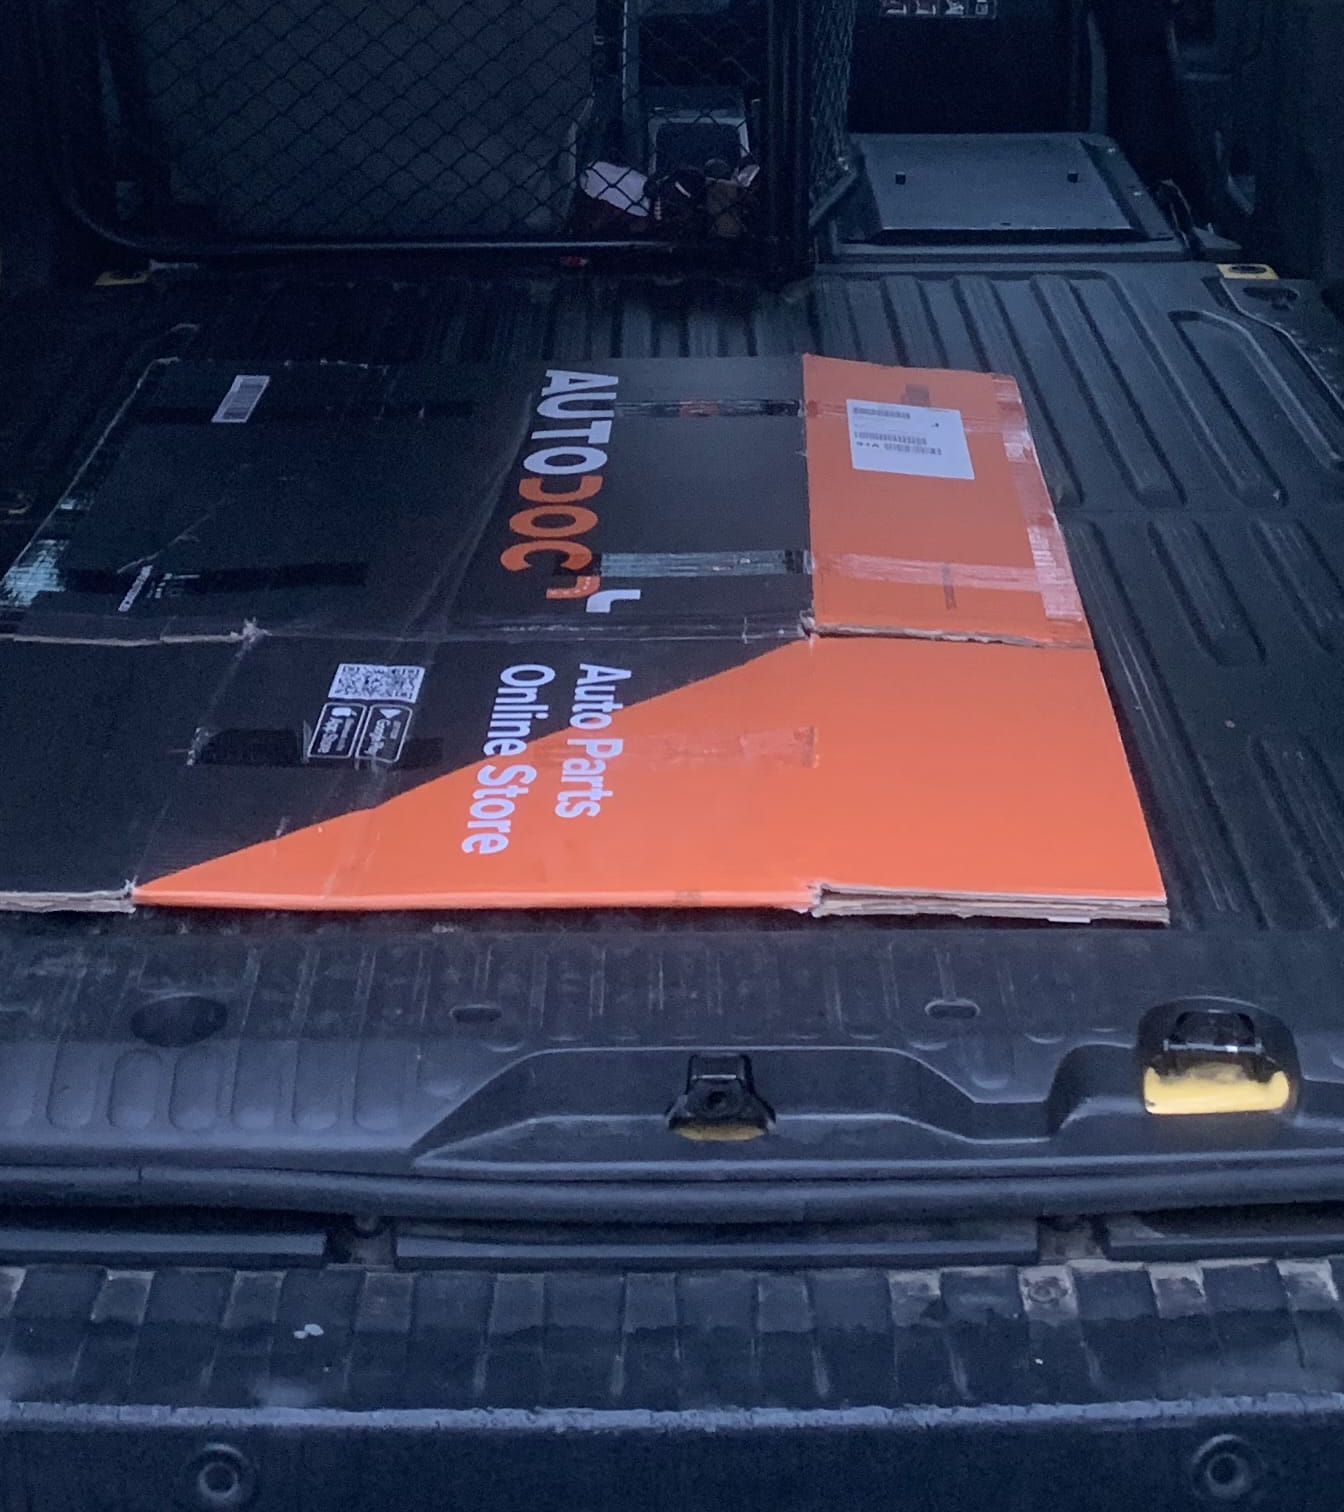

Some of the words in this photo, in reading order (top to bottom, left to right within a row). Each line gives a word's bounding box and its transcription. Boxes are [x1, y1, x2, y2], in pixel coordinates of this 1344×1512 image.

[500, 369, 619, 571] AUTODOC
[483, 664, 556, 756] Online
[570, 663, 632, 729] Auto
[461, 765, 537, 854] Store
[554, 738, 624, 818] Parts
